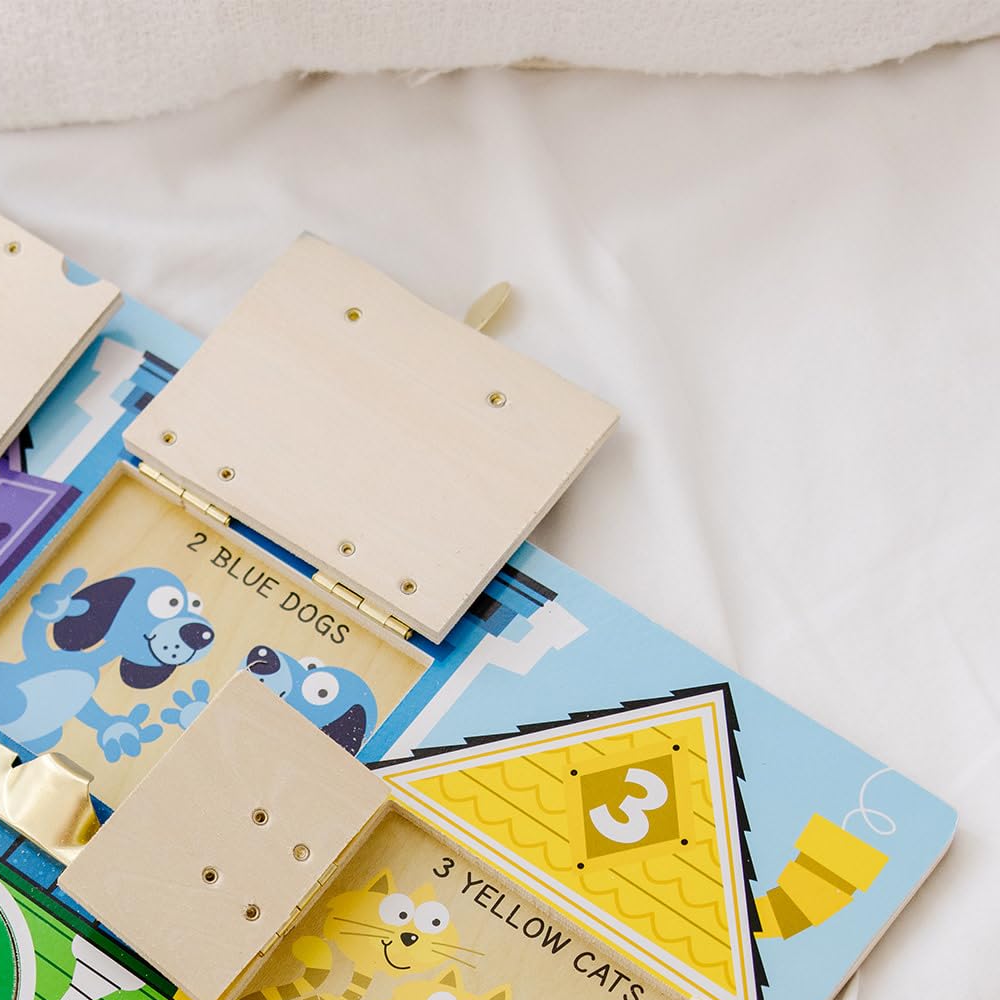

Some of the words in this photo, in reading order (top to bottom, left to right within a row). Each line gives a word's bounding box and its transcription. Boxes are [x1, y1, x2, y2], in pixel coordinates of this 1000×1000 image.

[186, 532, 208, 552] 2
[210, 545, 280, 599] BLUE
[279, 591, 350, 644] DOGS
[588, 767, 669, 844] 3
[432, 857, 456, 878] 3
[461, 871, 572, 954] YELLOW
